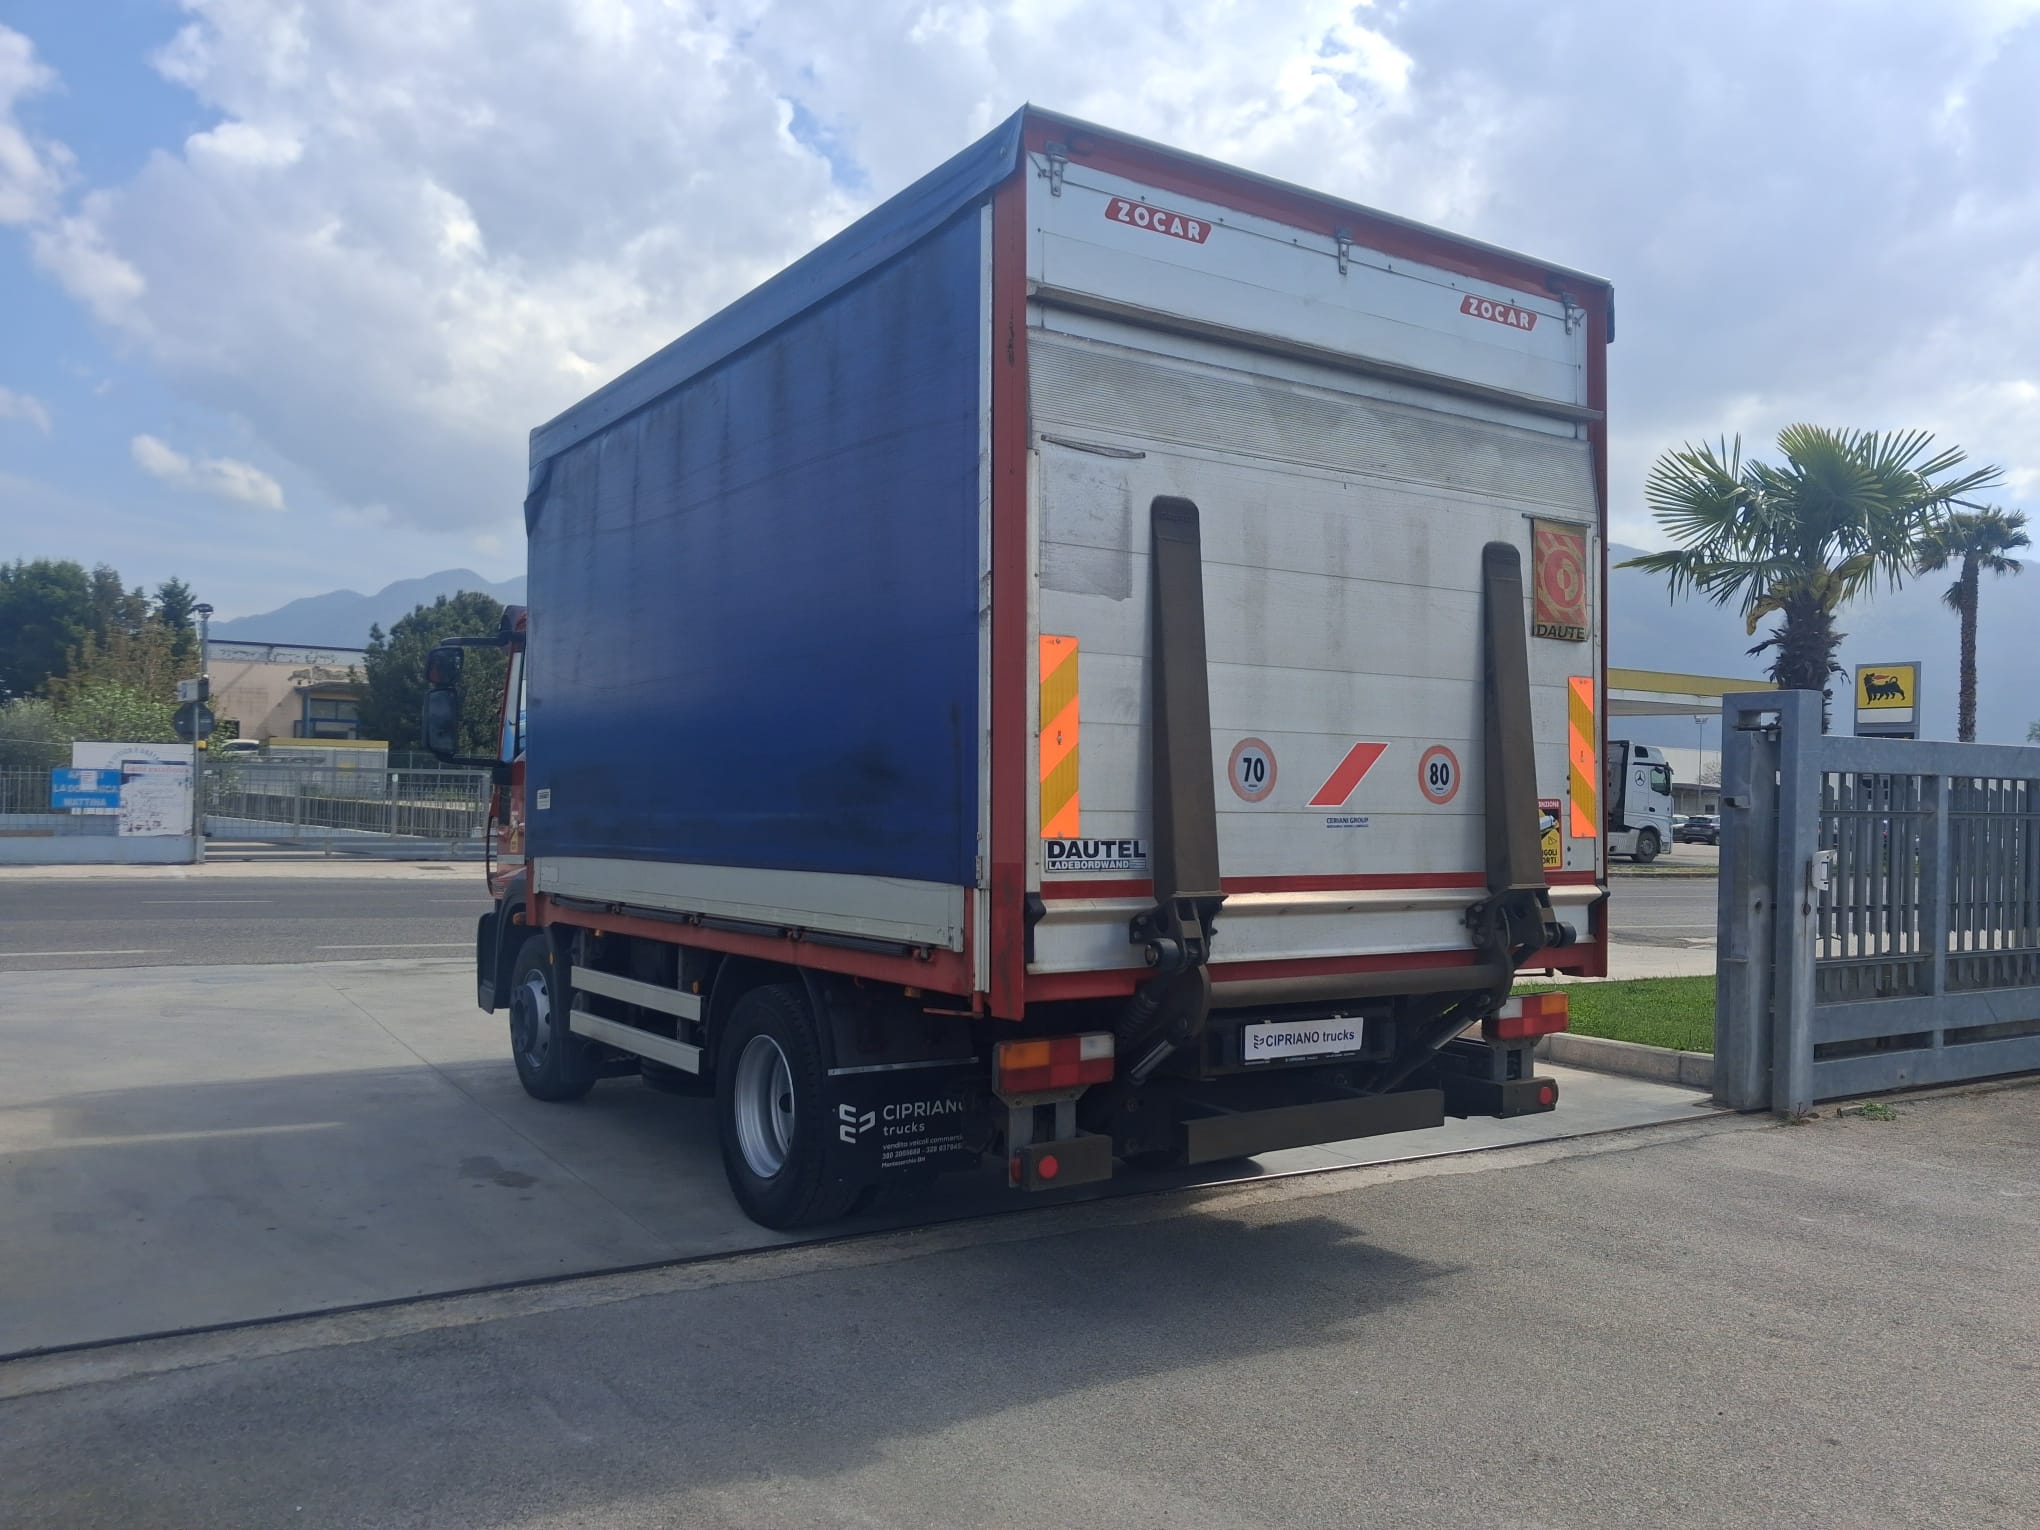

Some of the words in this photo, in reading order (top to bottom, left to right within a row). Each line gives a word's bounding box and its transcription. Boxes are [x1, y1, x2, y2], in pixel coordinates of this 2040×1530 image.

[1118, 201, 1200, 241] ZOCAR
[1469, 298, 1529, 328] ZOCAR
[1536, 624, 1585, 640] DAUTE
[1243, 757, 1264, 782] 70
[1430, 763, 1450, 785] 80
[1047, 840, 1147, 859] DAUTEL
[1543, 848, 1558, 856] GOLI
[1048, 860, 1129, 870] LADEBORDWAND
[1265, 1031, 1320, 1047] CIPRIANO
[1322, 1029, 1355, 1042] trucks
[883, 1122, 926, 1136] trucks
[929, 1134, 963, 1144] commerci
